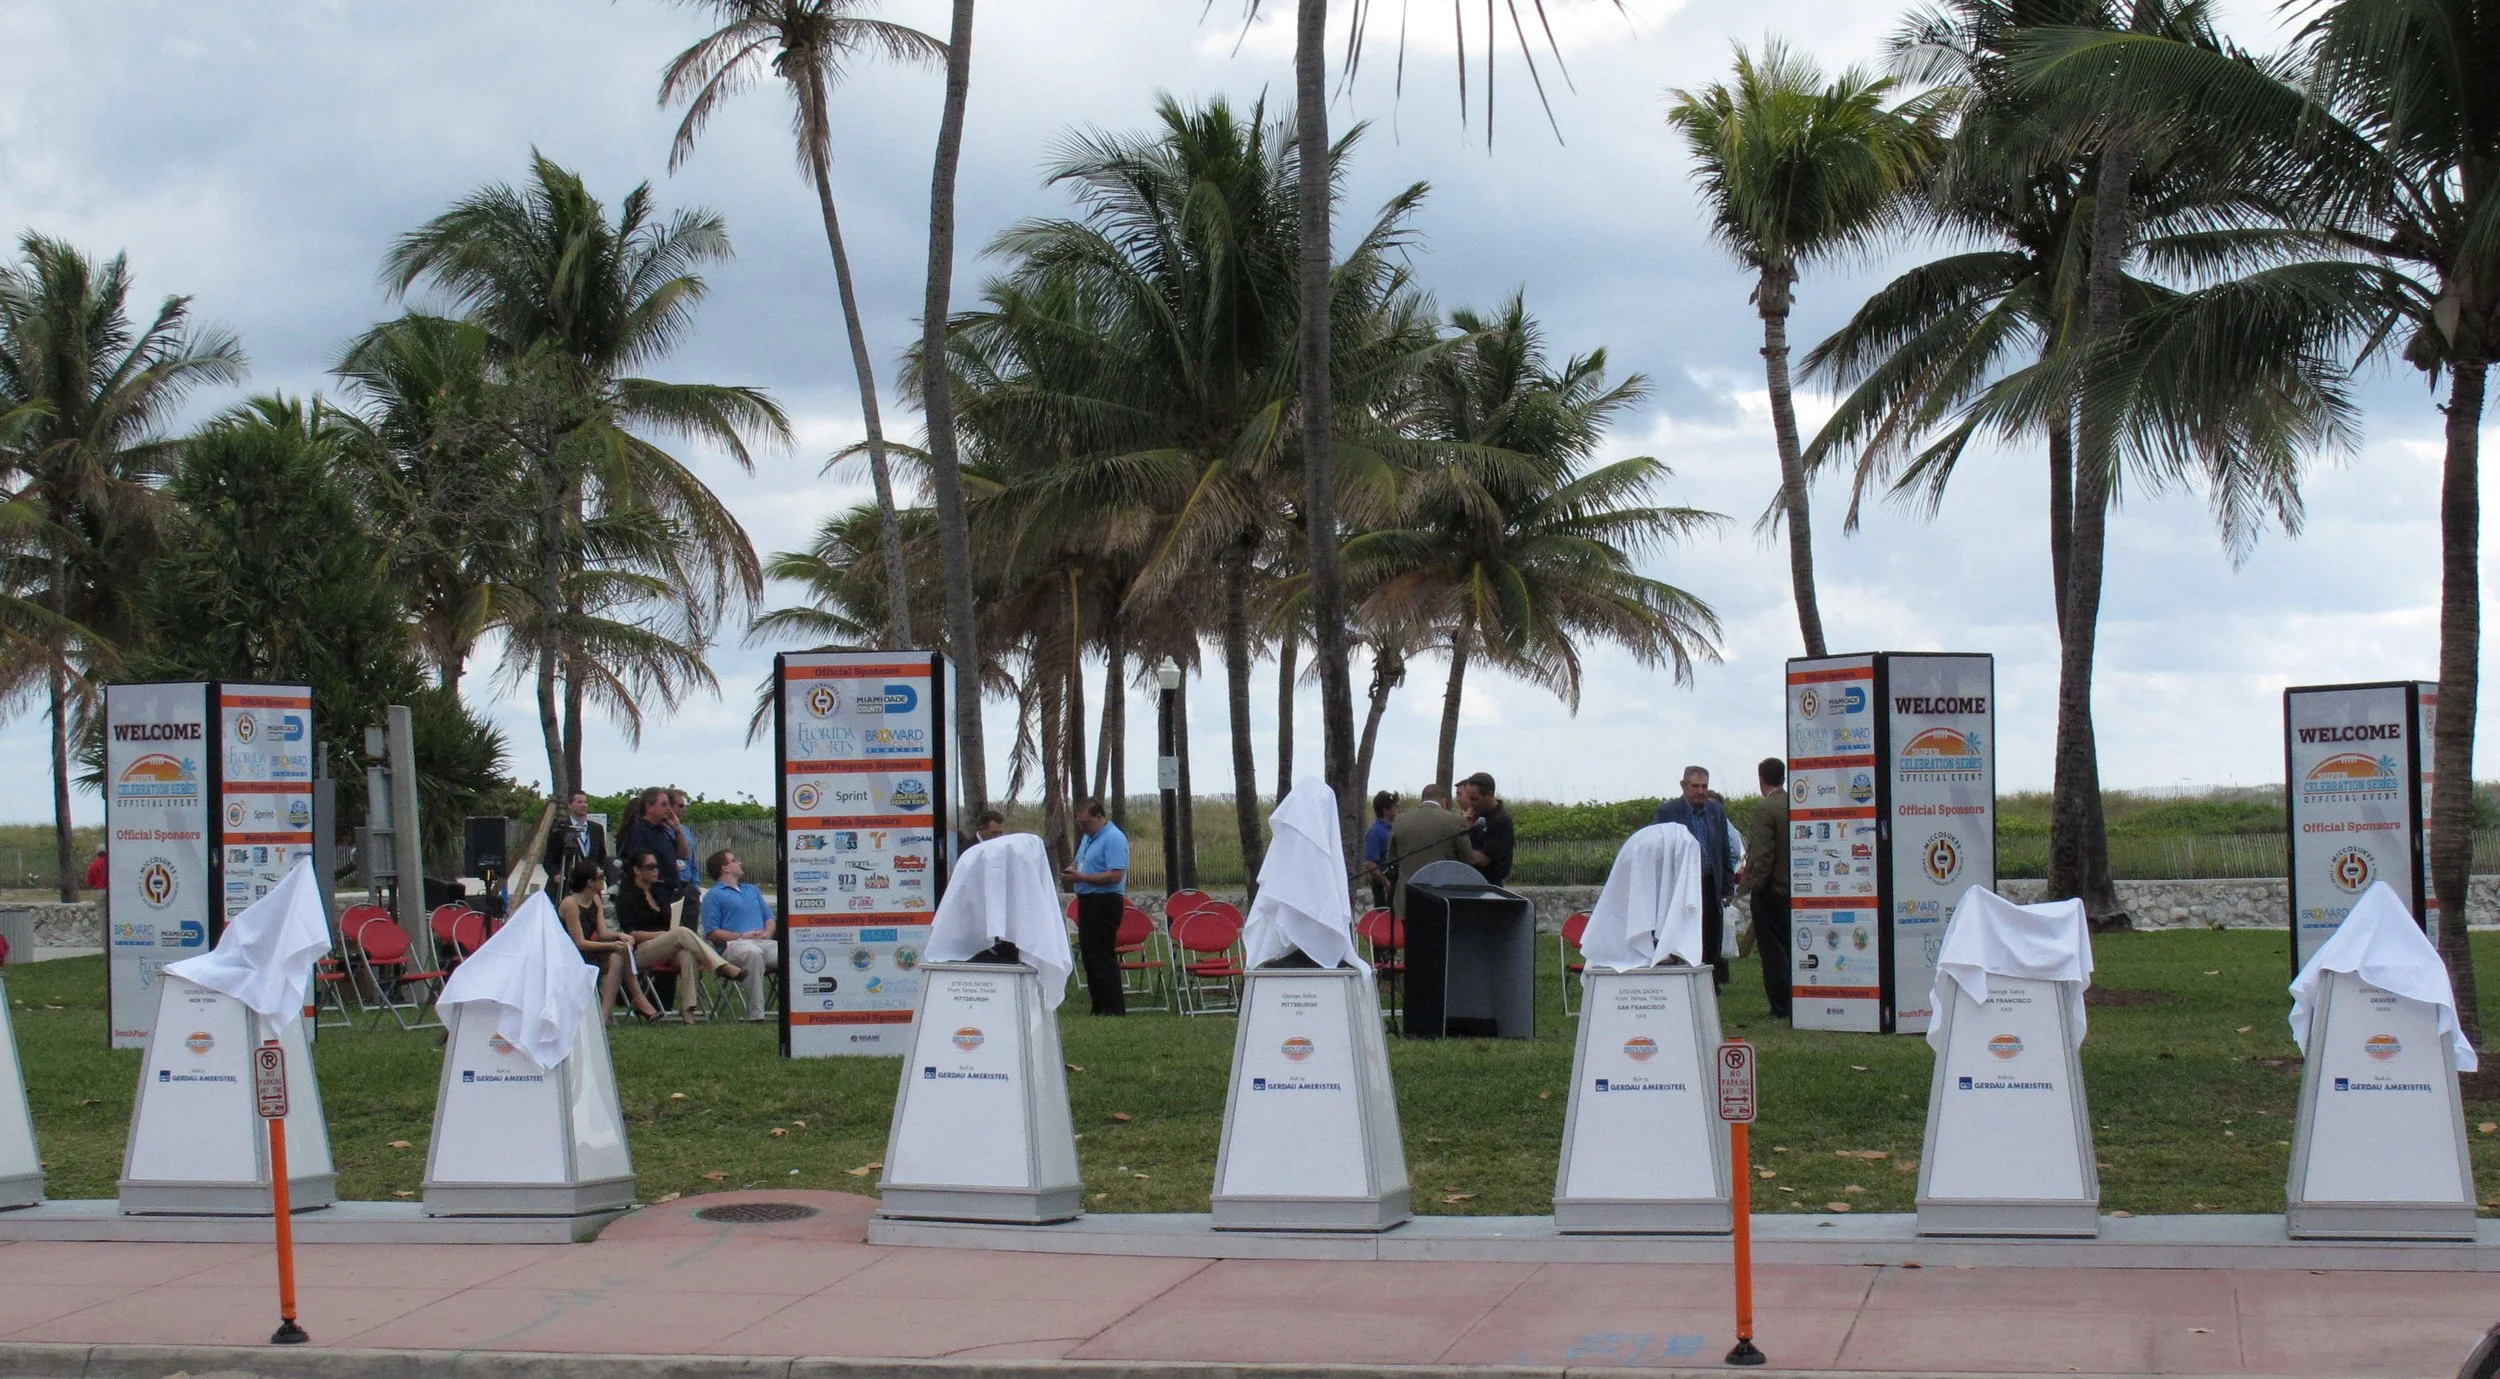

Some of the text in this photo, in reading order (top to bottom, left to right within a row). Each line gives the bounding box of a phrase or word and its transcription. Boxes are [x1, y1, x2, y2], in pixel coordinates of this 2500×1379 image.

[1896, 698, 1985, 714] WELCOME
[114, 724, 201, 741] WELCOME
[2298, 724, 2401, 744] WELCOME
[1900, 758, 1955, 770] CELEBRATION
[1900, 774, 1982, 783] OFFICIAL EVENT
[2304, 778, 2398, 793] CELEBRATION SERIES
[118, 798, 198, 808] OFFICIAL EVENT
[836, 791, 868, 803] Sprint
[2304, 792, 2398, 804] OFFICIAL EVENT
[254, 810, 275, 820] Sprint
[1899, 804, 1985, 817] Official Sponsors
[2304, 821, 2401, 833] Official Sponsors
[116, 830, 200, 843] Official Sponsors
[1897, 900, 1940, 914] BROWARD
[2007, 1082, 2053, 1090] AMERISTEEL
